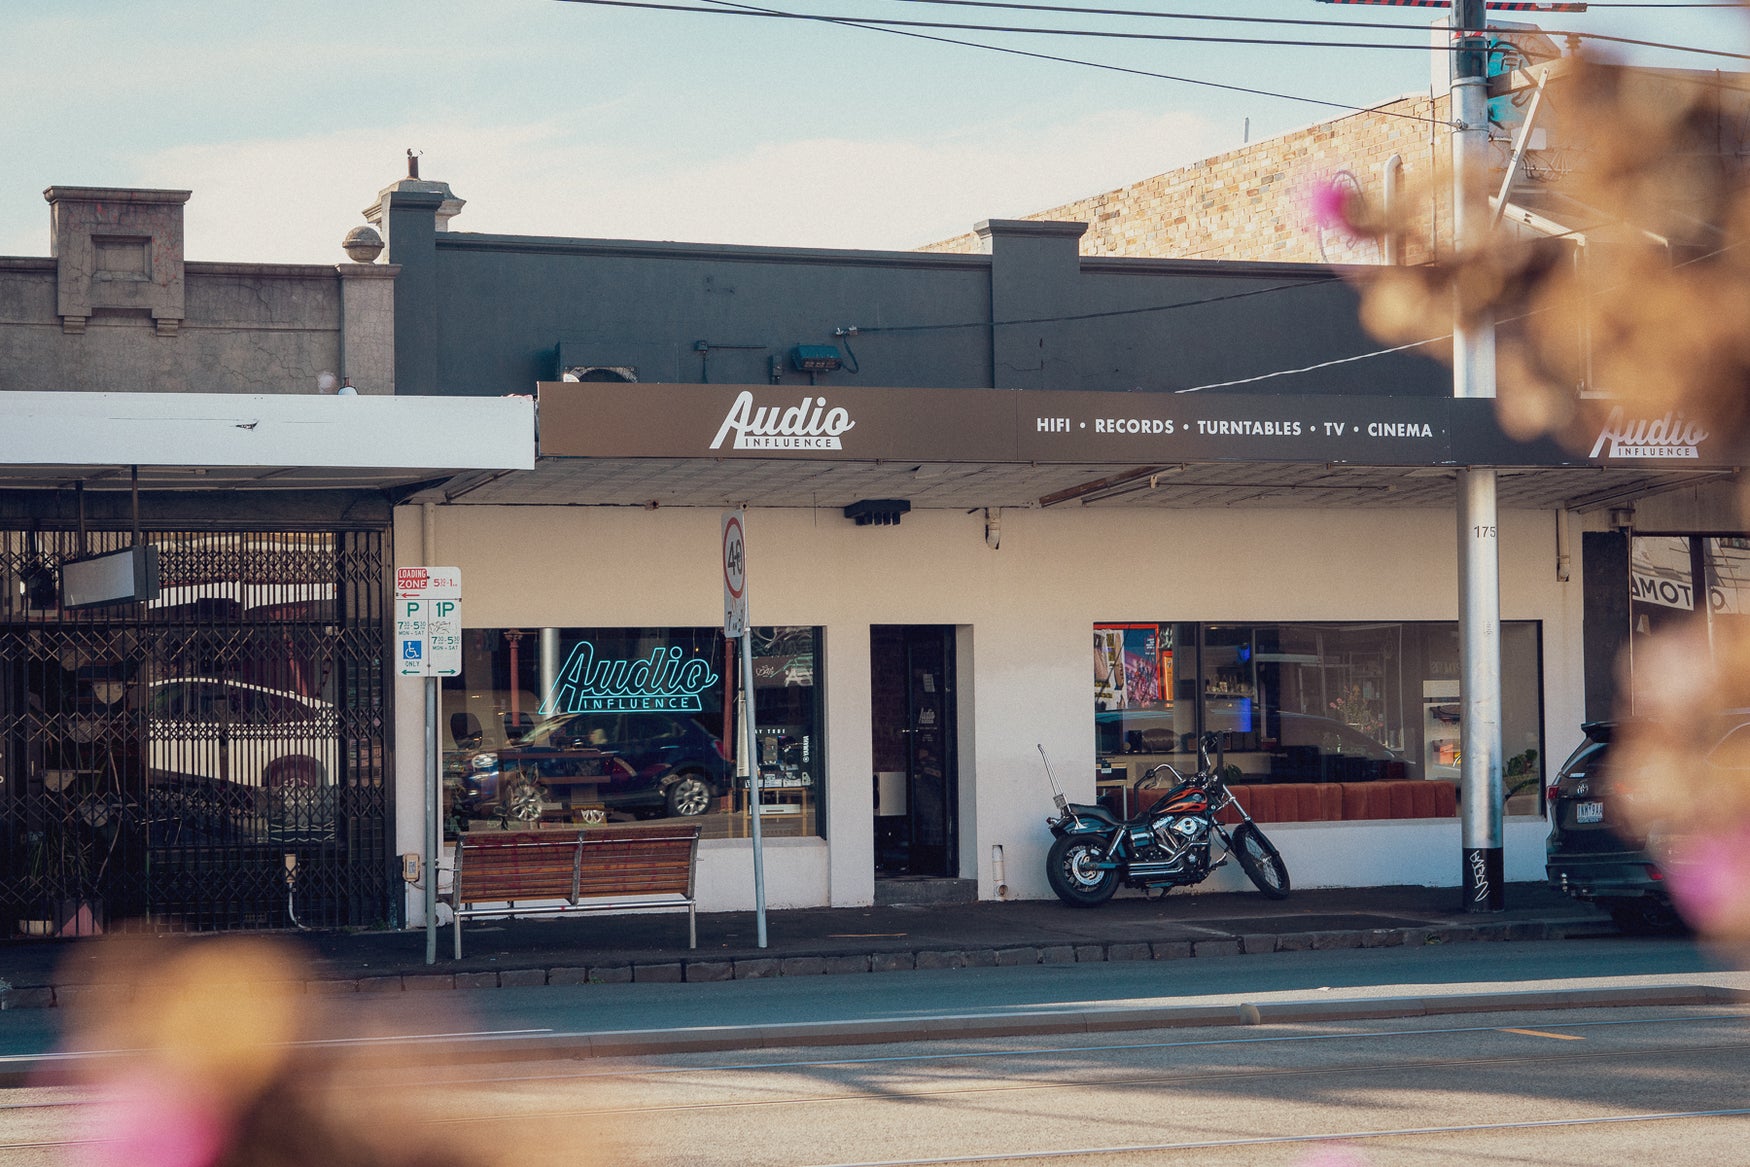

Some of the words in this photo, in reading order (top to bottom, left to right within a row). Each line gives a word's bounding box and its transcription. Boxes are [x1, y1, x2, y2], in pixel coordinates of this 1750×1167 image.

[708, 390, 856, 450] Audio
[1036, 417, 1071, 433] HIFI
[1094, 418, 1175, 435] RECORDS
[1197, 419, 1302, 436] TURNTABLES
[1323, 421, 1346, 437] TV
[1367, 422, 1433, 438] CINEMA
[1588, 404, 1710, 458] Audio
[744, 438, 832, 448] INFLUENCE
[1618, 447, 1690, 456] INFLUENCE
[1473, 525, 1497, 538] 175
[398, 569, 426, 579] LOADING
[398, 579, 427, 589] ZONE
[407, 601, 420, 618] P
[435, 601, 455, 618] 1P
[537, 640, 719, 715] Audio
[583, 697, 689, 710] INFLUENCE
